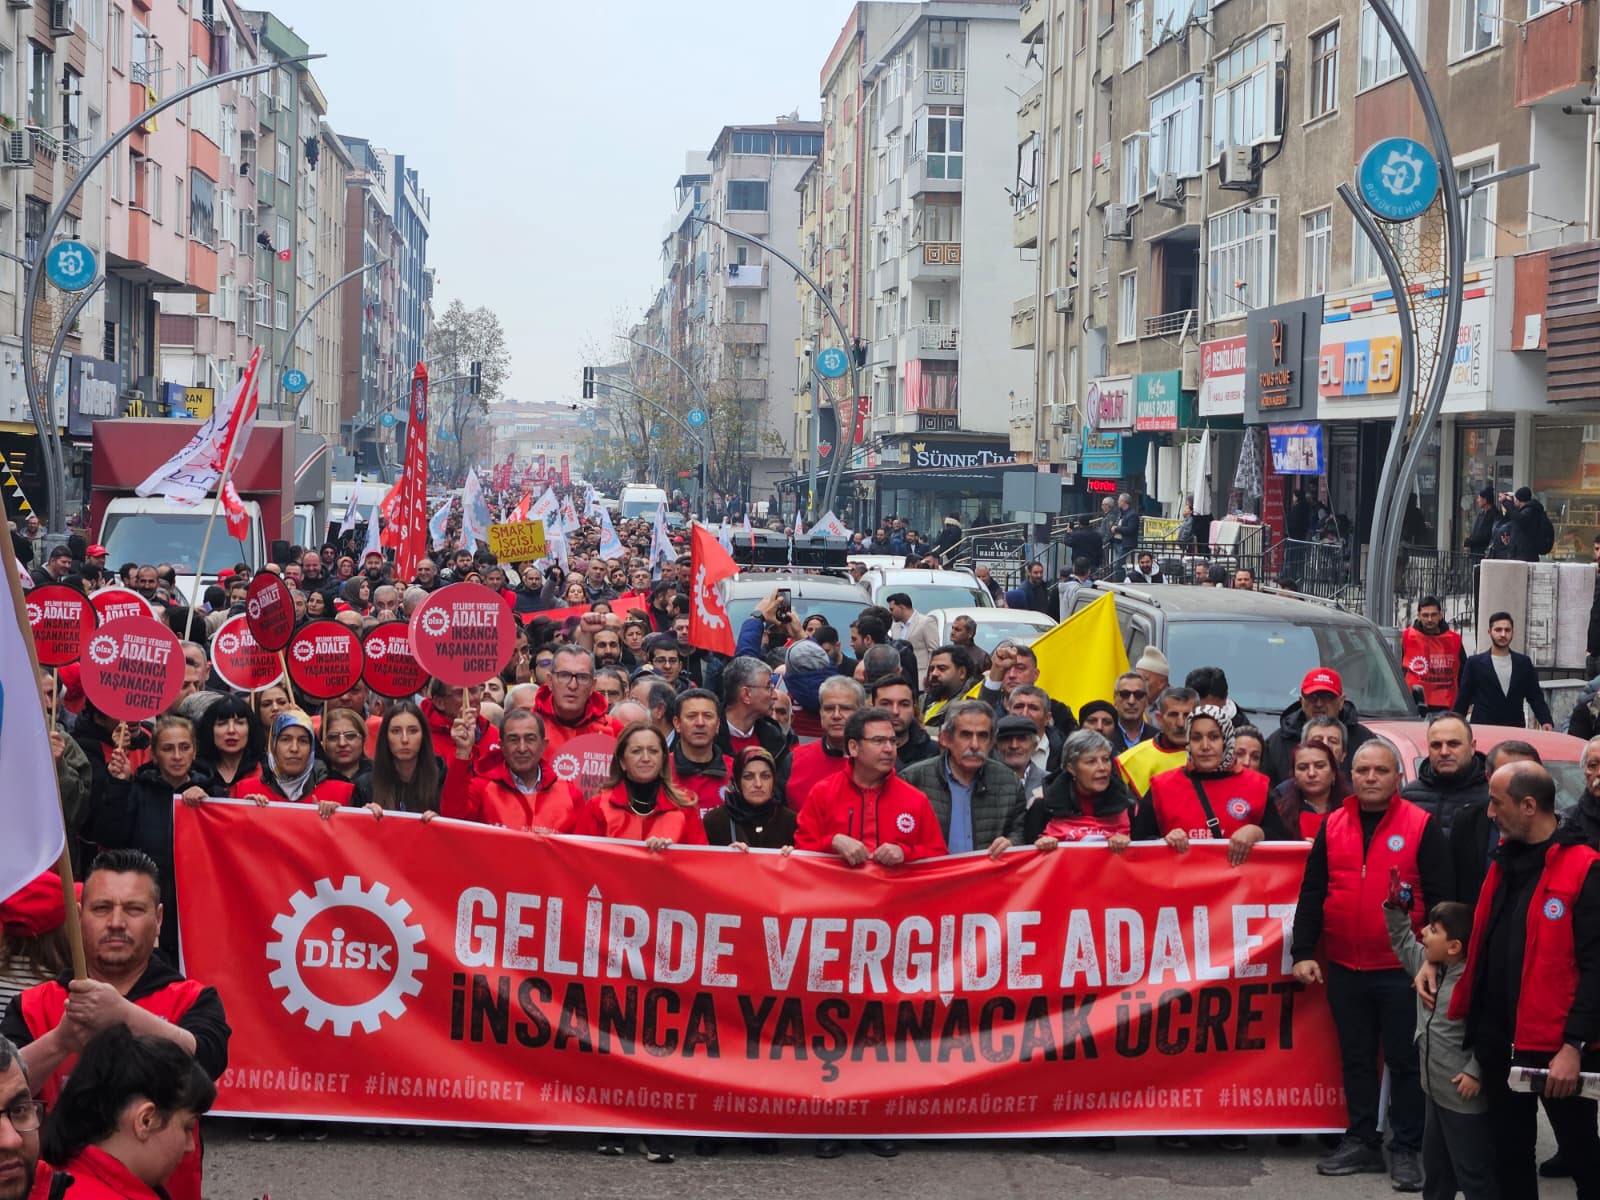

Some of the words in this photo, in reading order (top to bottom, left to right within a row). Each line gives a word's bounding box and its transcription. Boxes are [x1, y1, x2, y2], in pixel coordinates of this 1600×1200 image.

[491, 522, 535, 539] SMART
[44, 607, 82, 620] ADALET
[452, 611, 498, 627] ADALET
[452, 626, 498, 640] İNSANCA
[120, 642, 171, 664] ADALET
[316, 642, 350, 654] ADALET
[436, 642, 498, 660] YAŞANACAK
[118, 658, 167, 678] İNSANCA
[464, 658, 498, 672] ÜCRET
[100, 671, 164, 695] YAŞANACAK
[126, 692, 162, 710] ÜCRET
[455, 884, 742, 988] GELİRDE
[302, 927, 394, 971] DİSK
[450, 973, 721, 1059] İNSANCA
[741, 991, 1099, 1083] YAŞANACAK
[1114, 981, 1307, 1058] ÜCRET
[365, 1072, 525, 1101] #İNSANCAÜCRET
[540, 1080, 696, 1110] #İNSANCAÜCRET
[713, 1090, 870, 1116] #İNSANCAÜCRET
[884, 1091, 1038, 1116] #İNSANCAÜCRET
[1052, 1086, 1204, 1112] #İNSANCAÜCRET
